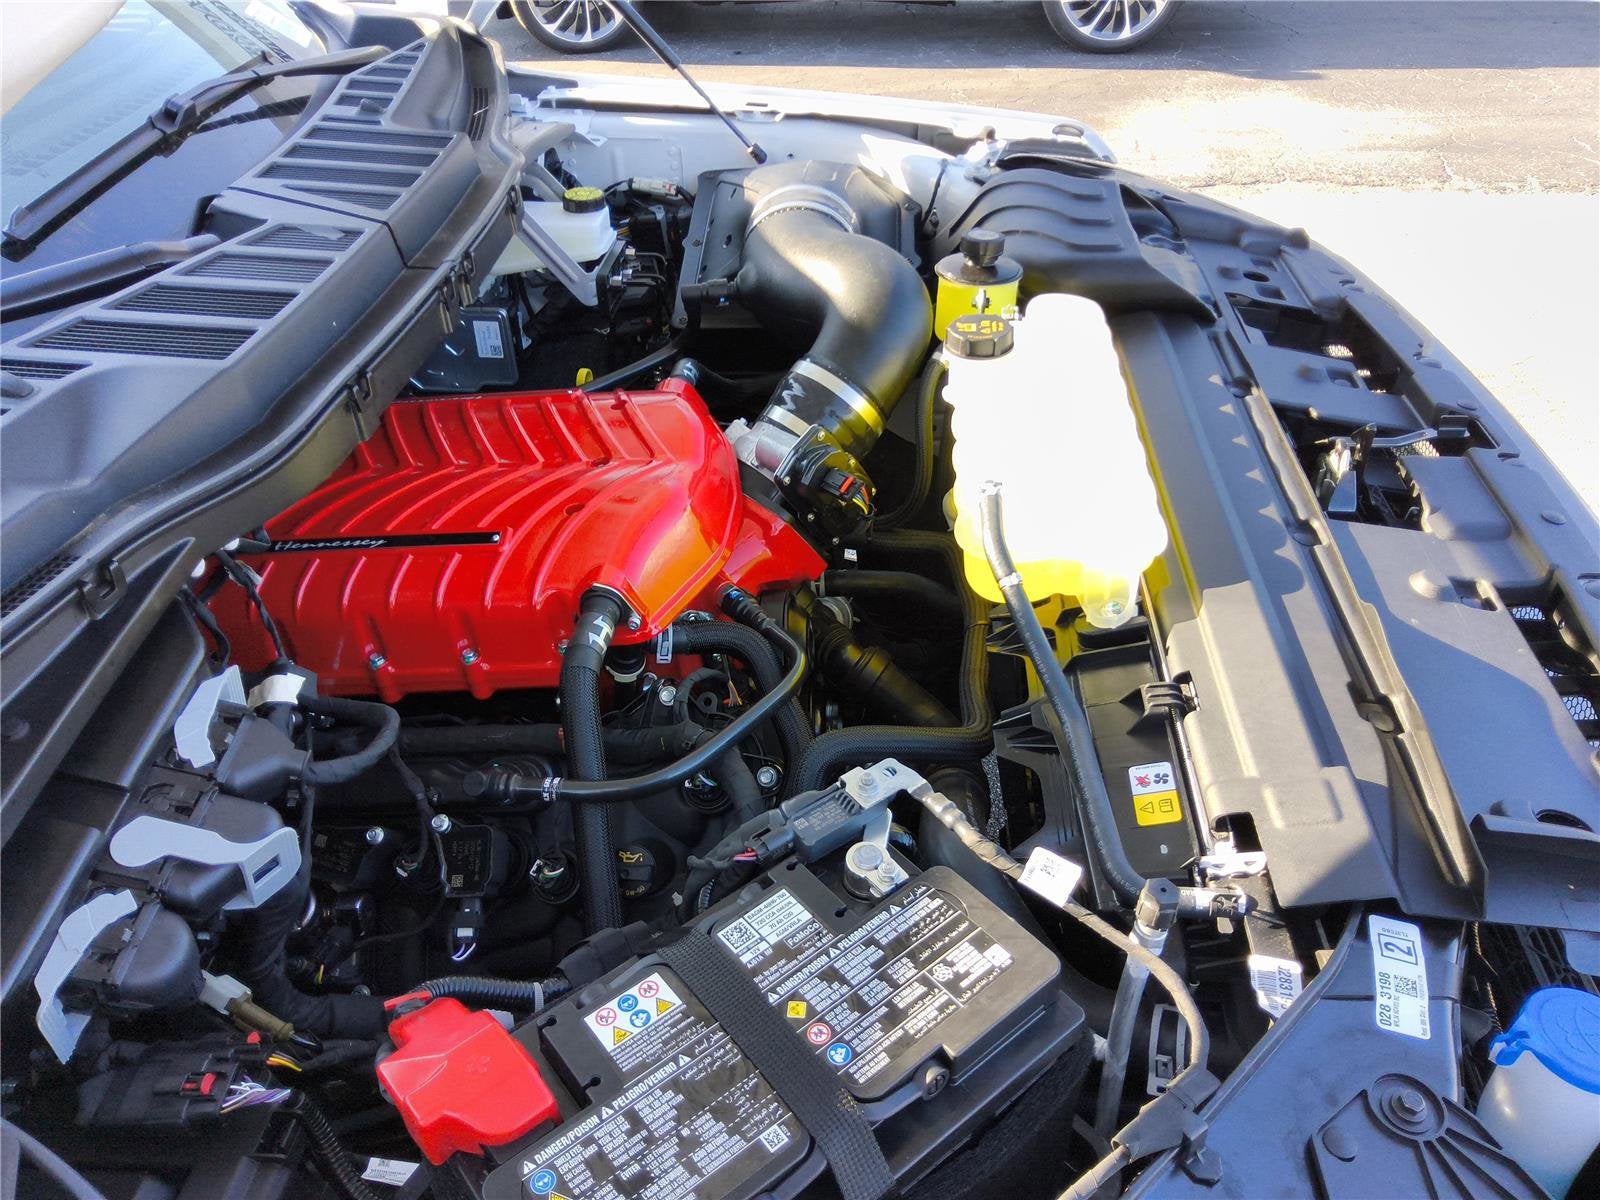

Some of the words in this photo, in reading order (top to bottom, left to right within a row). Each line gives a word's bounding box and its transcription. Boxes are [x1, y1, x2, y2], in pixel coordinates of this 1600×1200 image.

[275, 538, 388, 551] Hennessey
[786, 920, 820, 946] FoMoCo
[774, 953, 831, 996] DANGER/POISON
[836, 909, 892, 951] PELIGRO/VENENO
[1384, 941, 1414, 958] 2
[1378, 971, 1392, 1000] 3198
[1379, 1003, 1392, 1027] 028
[852, 1023, 863, 1033] ALL
[632, 1093, 655, 1112] PROTEJA
[651, 1087, 663, 1099] LOS
[649, 1098, 662, 1109] LOS
[657, 1088, 675, 1104] GASES
[532, 1113, 601, 1166] DANGER/POISON
[610, 1060, 679, 1111] PELIGRO/VENENO
[613, 1113, 626, 1125] LES
[679, 1126, 691, 1137] NO
[692, 1110, 713, 1128] CHISPAS
[610, 1126, 622, 1138] LES
[618, 1120, 631, 1132] GAZ
[696, 1117, 717, 1134] FLAMAS
[601, 1132, 628, 1154] EXPLOSIFS
[552, 1151, 572, 1168] SHIELD
[568, 1142, 585, 1157] EYES.
[557, 1152, 584, 1175] EXPLOSIVE
[580, 1142, 599, 1158] GASES
[643, 1152, 655, 1164] LES
[647, 1159, 659, 1170] LES
[652, 1166, 662, 1176] DE
[658, 1155, 677, 1172] FUMER
[562, 1170, 575, 1182] CAN
[571, 1161, 587, 1176] CAUSE
[592, 1182, 614, 1200] SPARKS
[670, 1179, 679, 1189] LA
